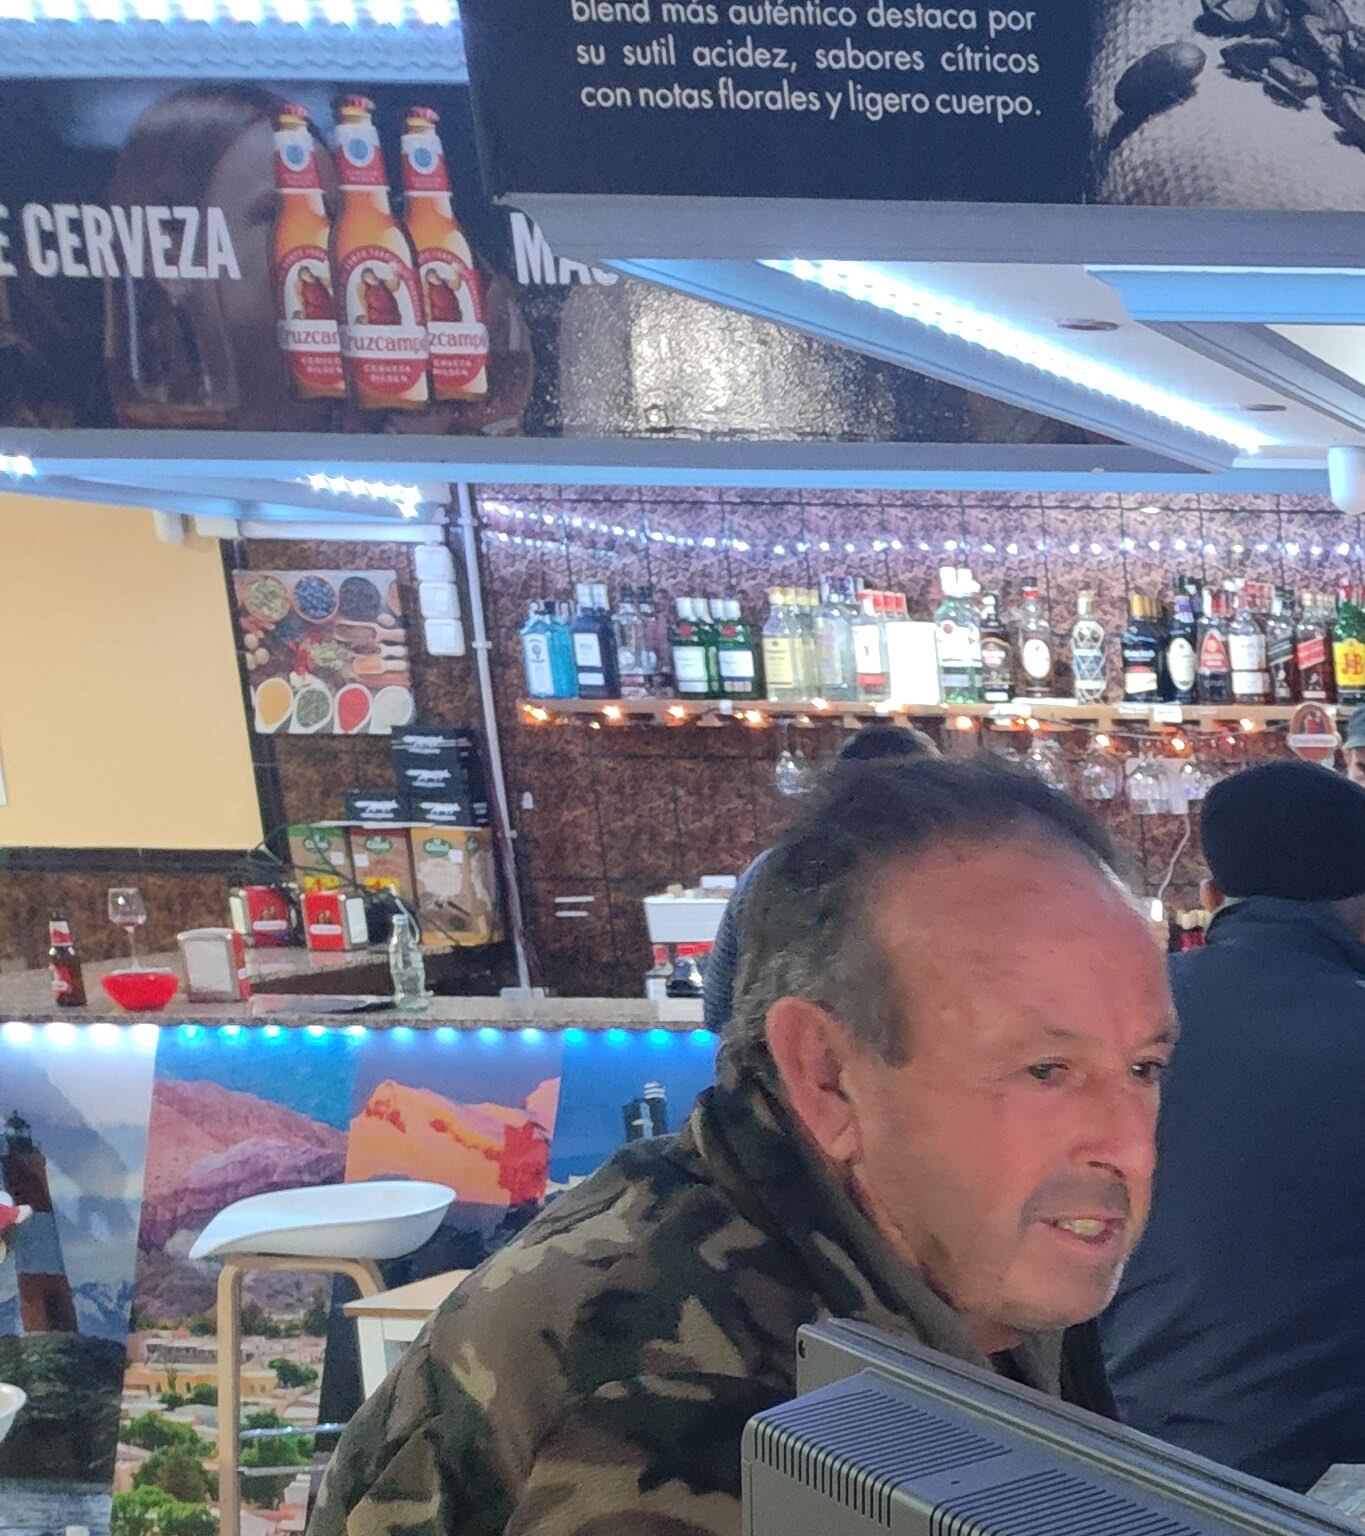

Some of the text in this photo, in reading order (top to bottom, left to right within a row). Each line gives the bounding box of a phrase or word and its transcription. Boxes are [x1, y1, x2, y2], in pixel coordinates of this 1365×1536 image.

[572, 0, 1036, 38] blend más auténtico destaca por
[576, 34, 1040, 74] su sutil acidez, sabores cítricos
[580, 76, 1041, 124] con notas florales y ligero cuerpo.
[22, 202, 242, 280] CERVEZA
